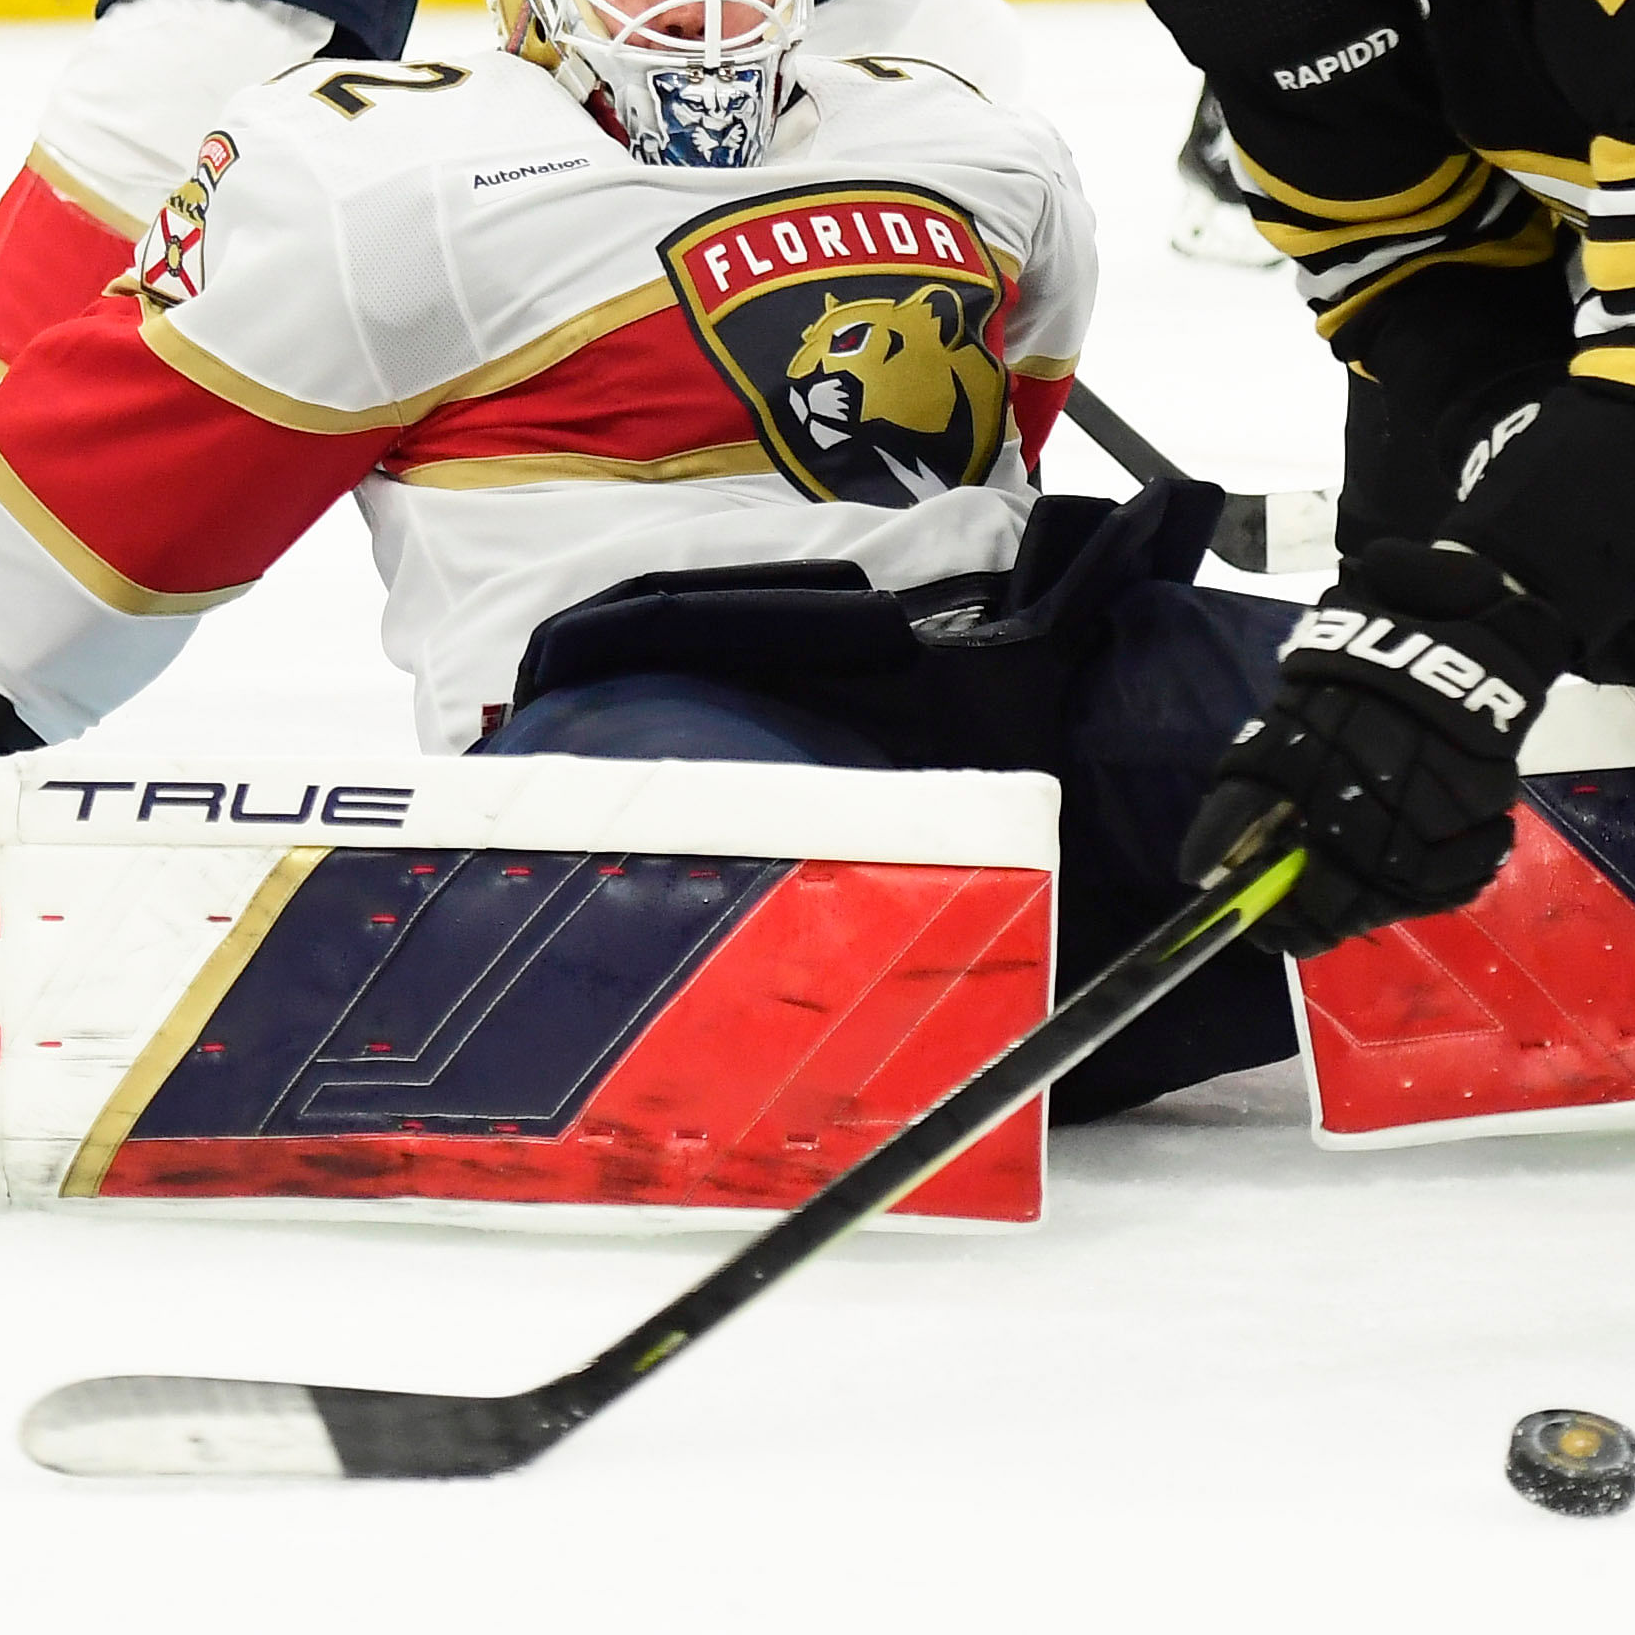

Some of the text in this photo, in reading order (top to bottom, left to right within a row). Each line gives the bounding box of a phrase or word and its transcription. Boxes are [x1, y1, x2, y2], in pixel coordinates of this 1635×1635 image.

[1273, 28, 1399, 90] RAPID7
[473, 157, 590, 190] AutoNation
[703, 211, 965, 293] FLORIDA
[38, 780, 417, 828] TRUE
